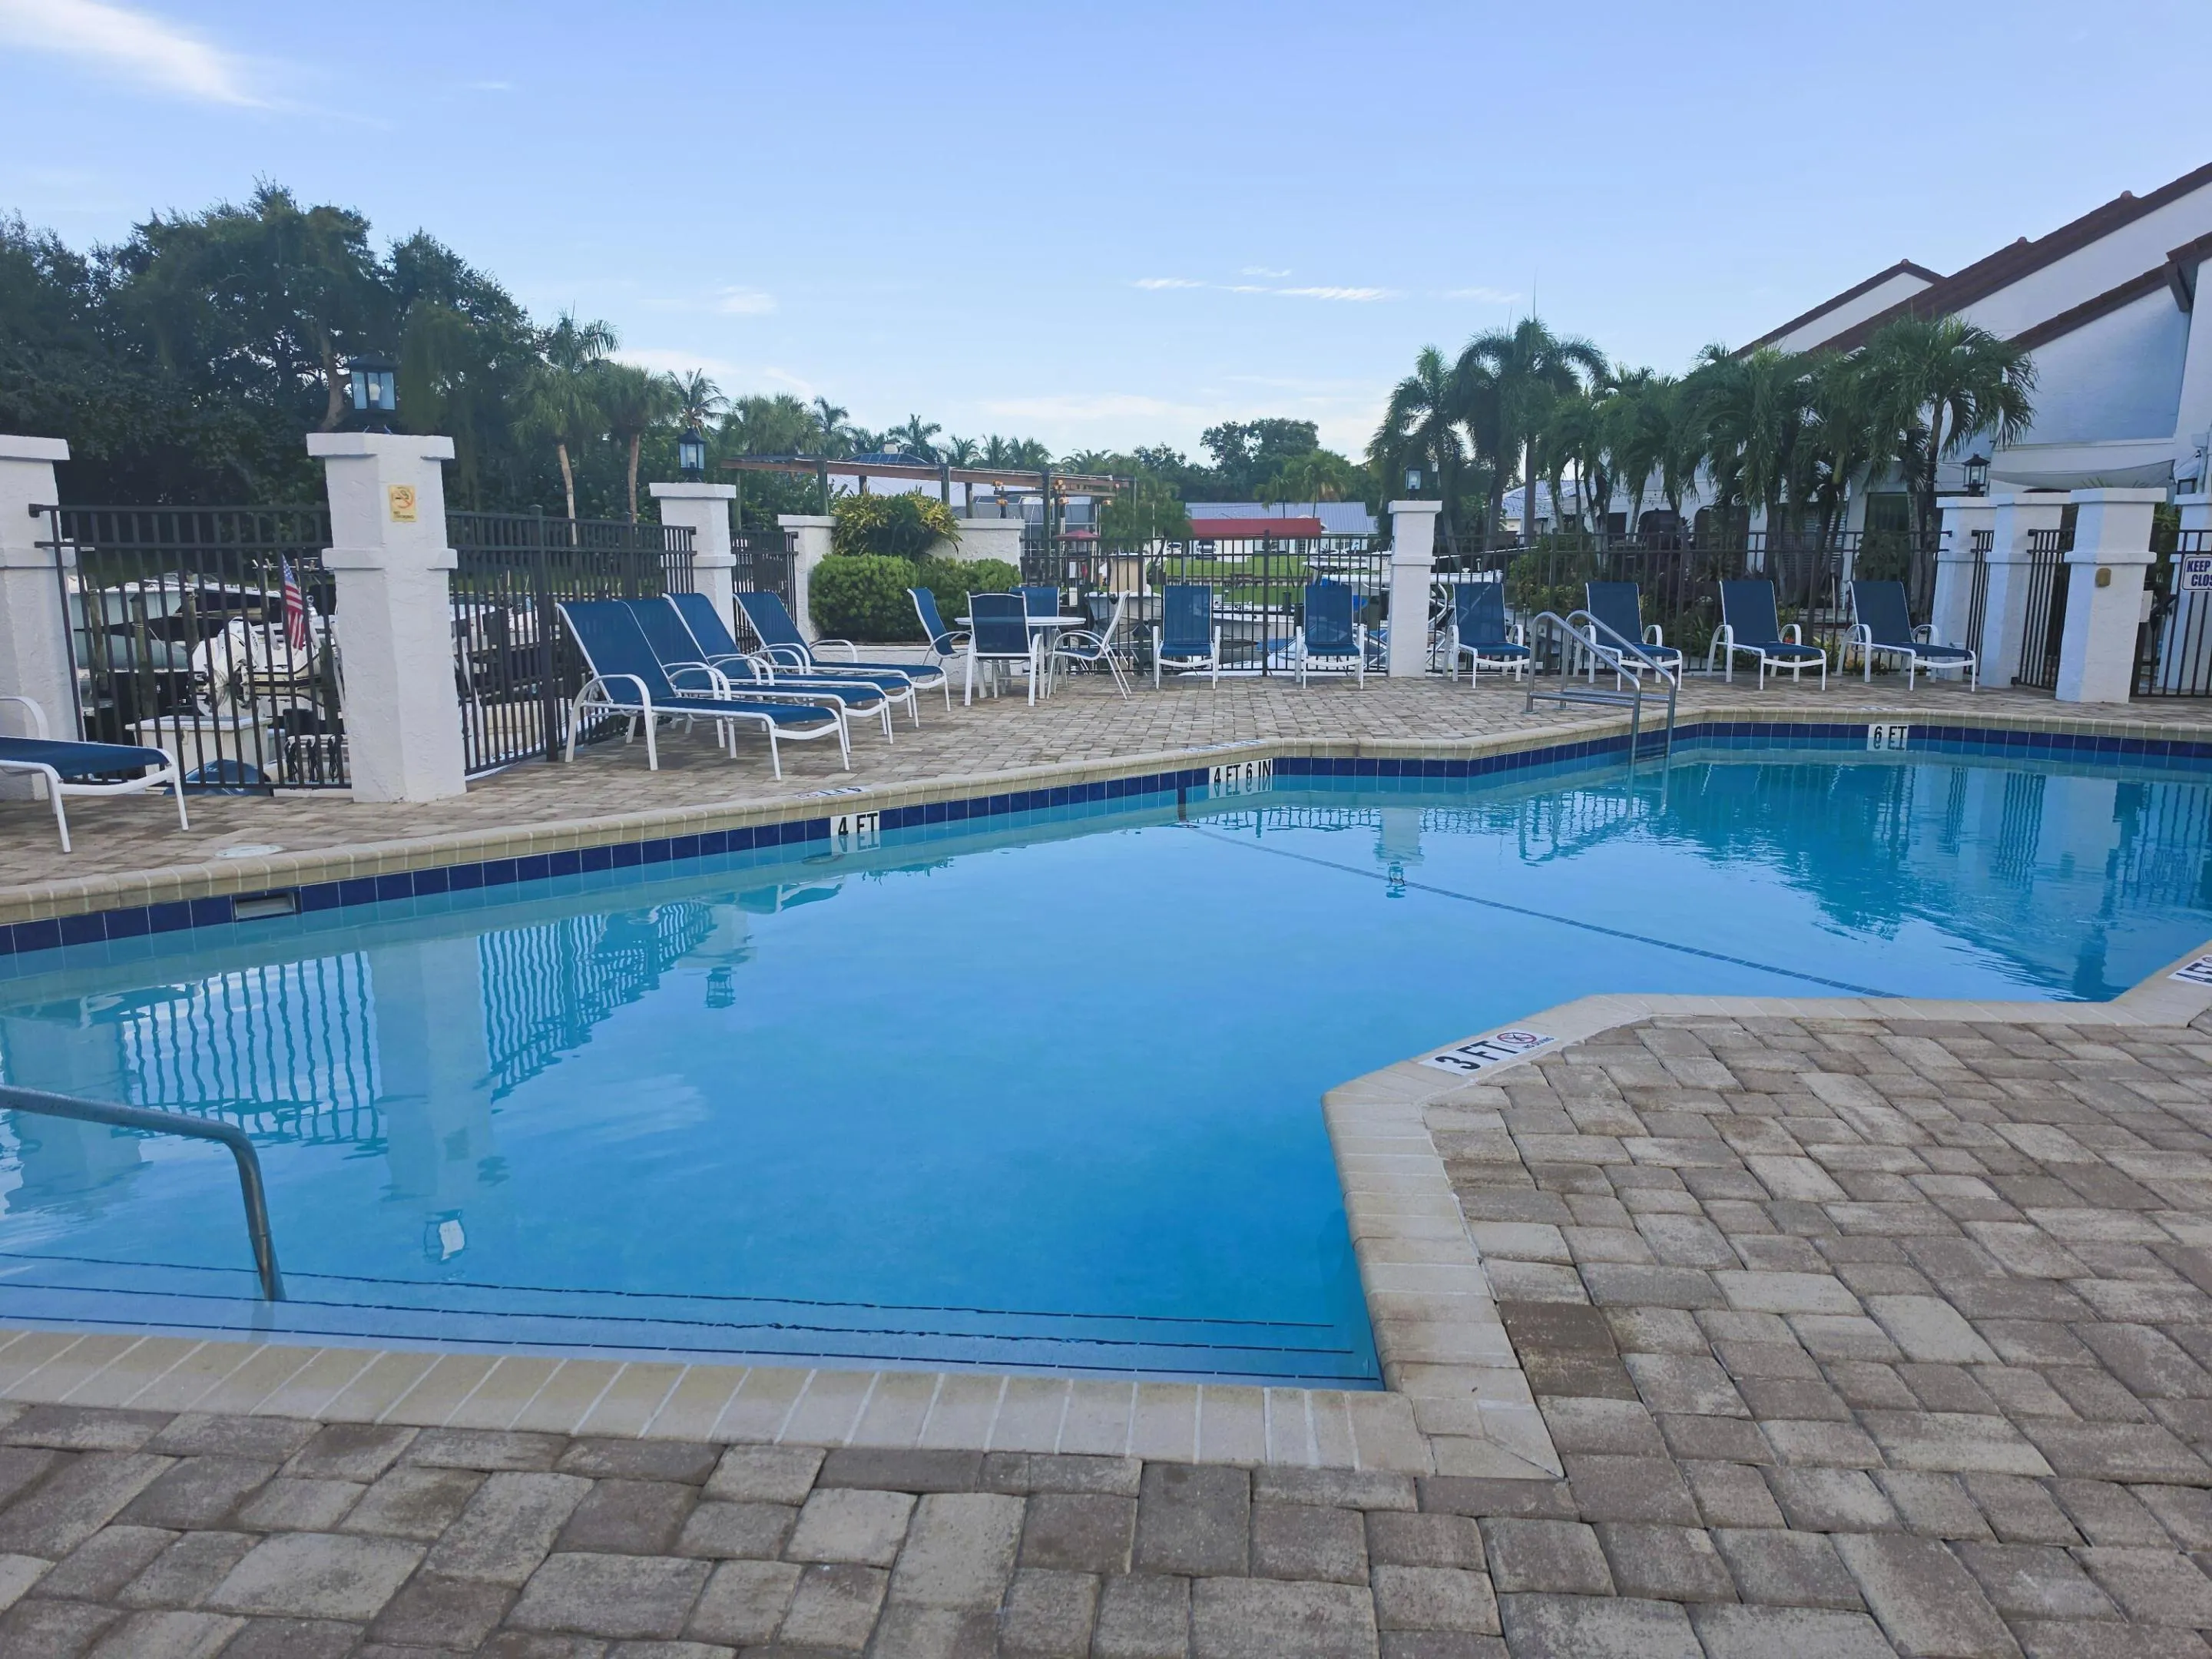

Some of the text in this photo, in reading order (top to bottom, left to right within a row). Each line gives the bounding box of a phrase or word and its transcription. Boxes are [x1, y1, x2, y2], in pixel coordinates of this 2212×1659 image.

[2187, 560, 2210, 572] KEEP
[1874, 726, 1908, 739] 6 FT
[1214, 760, 1272, 783] 4 FT 6 IN
[838, 813, 879, 836] 4 FT
[1435, 1040, 1520, 1070] 3 FT
